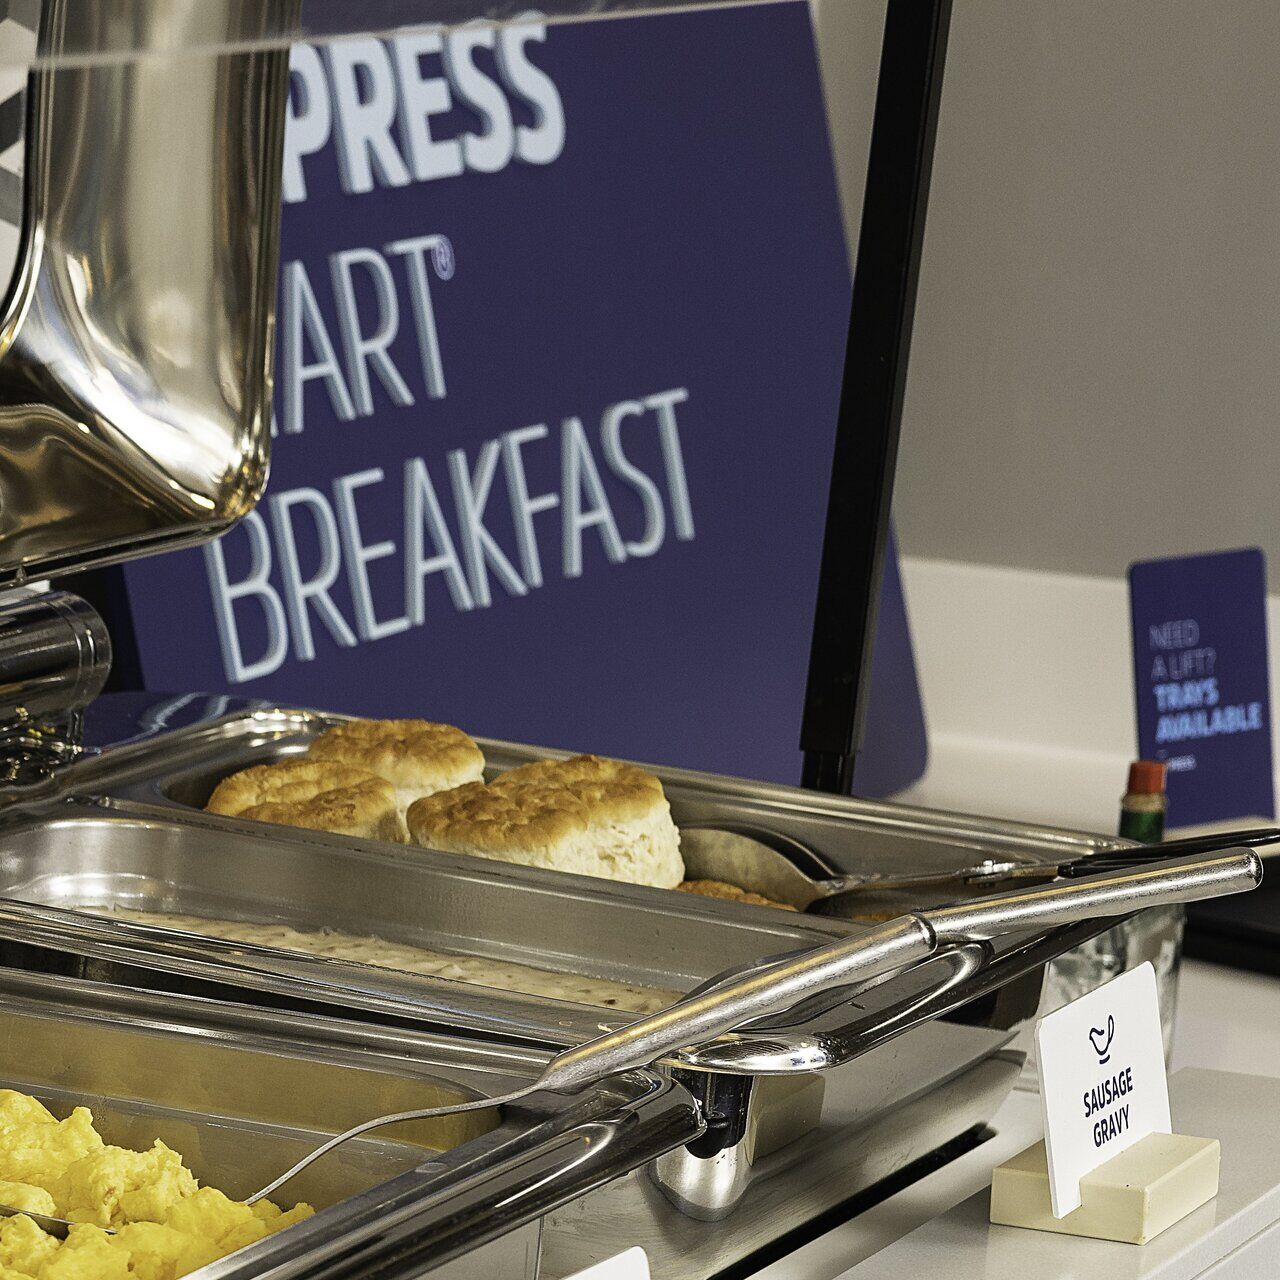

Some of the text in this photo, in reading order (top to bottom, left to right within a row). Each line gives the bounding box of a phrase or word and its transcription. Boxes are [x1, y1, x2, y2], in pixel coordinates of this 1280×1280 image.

[282, 11, 566, 203] PRESS
[271, 233, 448, 437] ART
[207, 388, 696, 685] BREAKFAST
[1149, 618, 1200, 649] NEED
[1151, 654, 1169, 681] A
[1153, 676, 1220, 712] TRAYS
[1155, 701, 1263, 744] AVAILABLE
[1083, 1067, 1133, 1118] SAUSAGE
[1093, 1104, 1130, 1148] GRAVY
